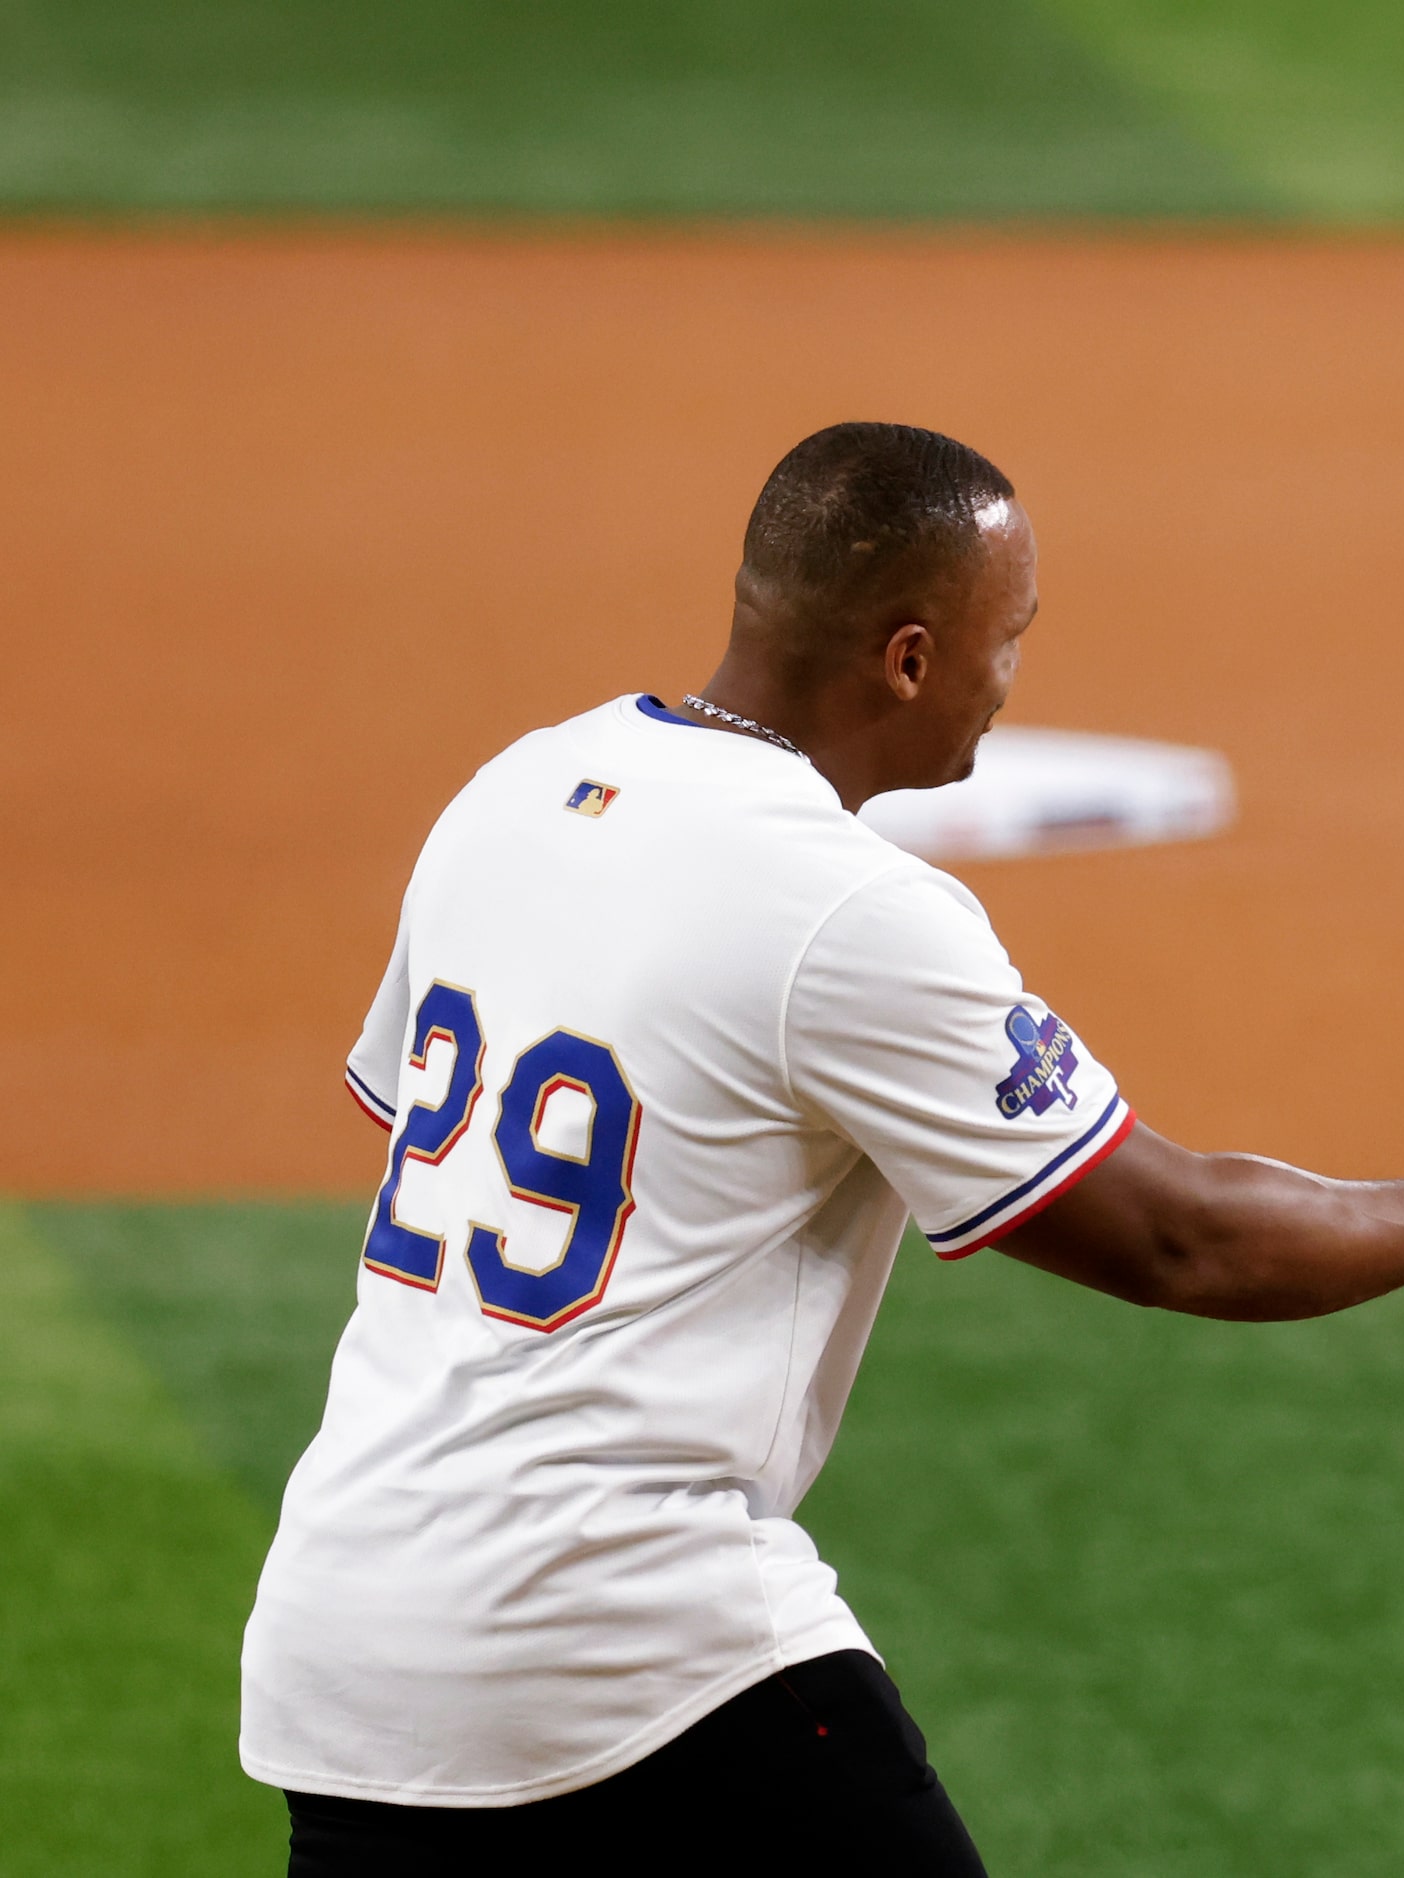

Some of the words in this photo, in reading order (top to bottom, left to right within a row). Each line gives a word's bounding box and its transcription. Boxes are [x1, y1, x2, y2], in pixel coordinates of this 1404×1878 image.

[1001, 1020, 1072, 1114] CHAMPIONS
[1045, 1065, 1074, 1105] T
[364, 978, 642, 1333] 29
